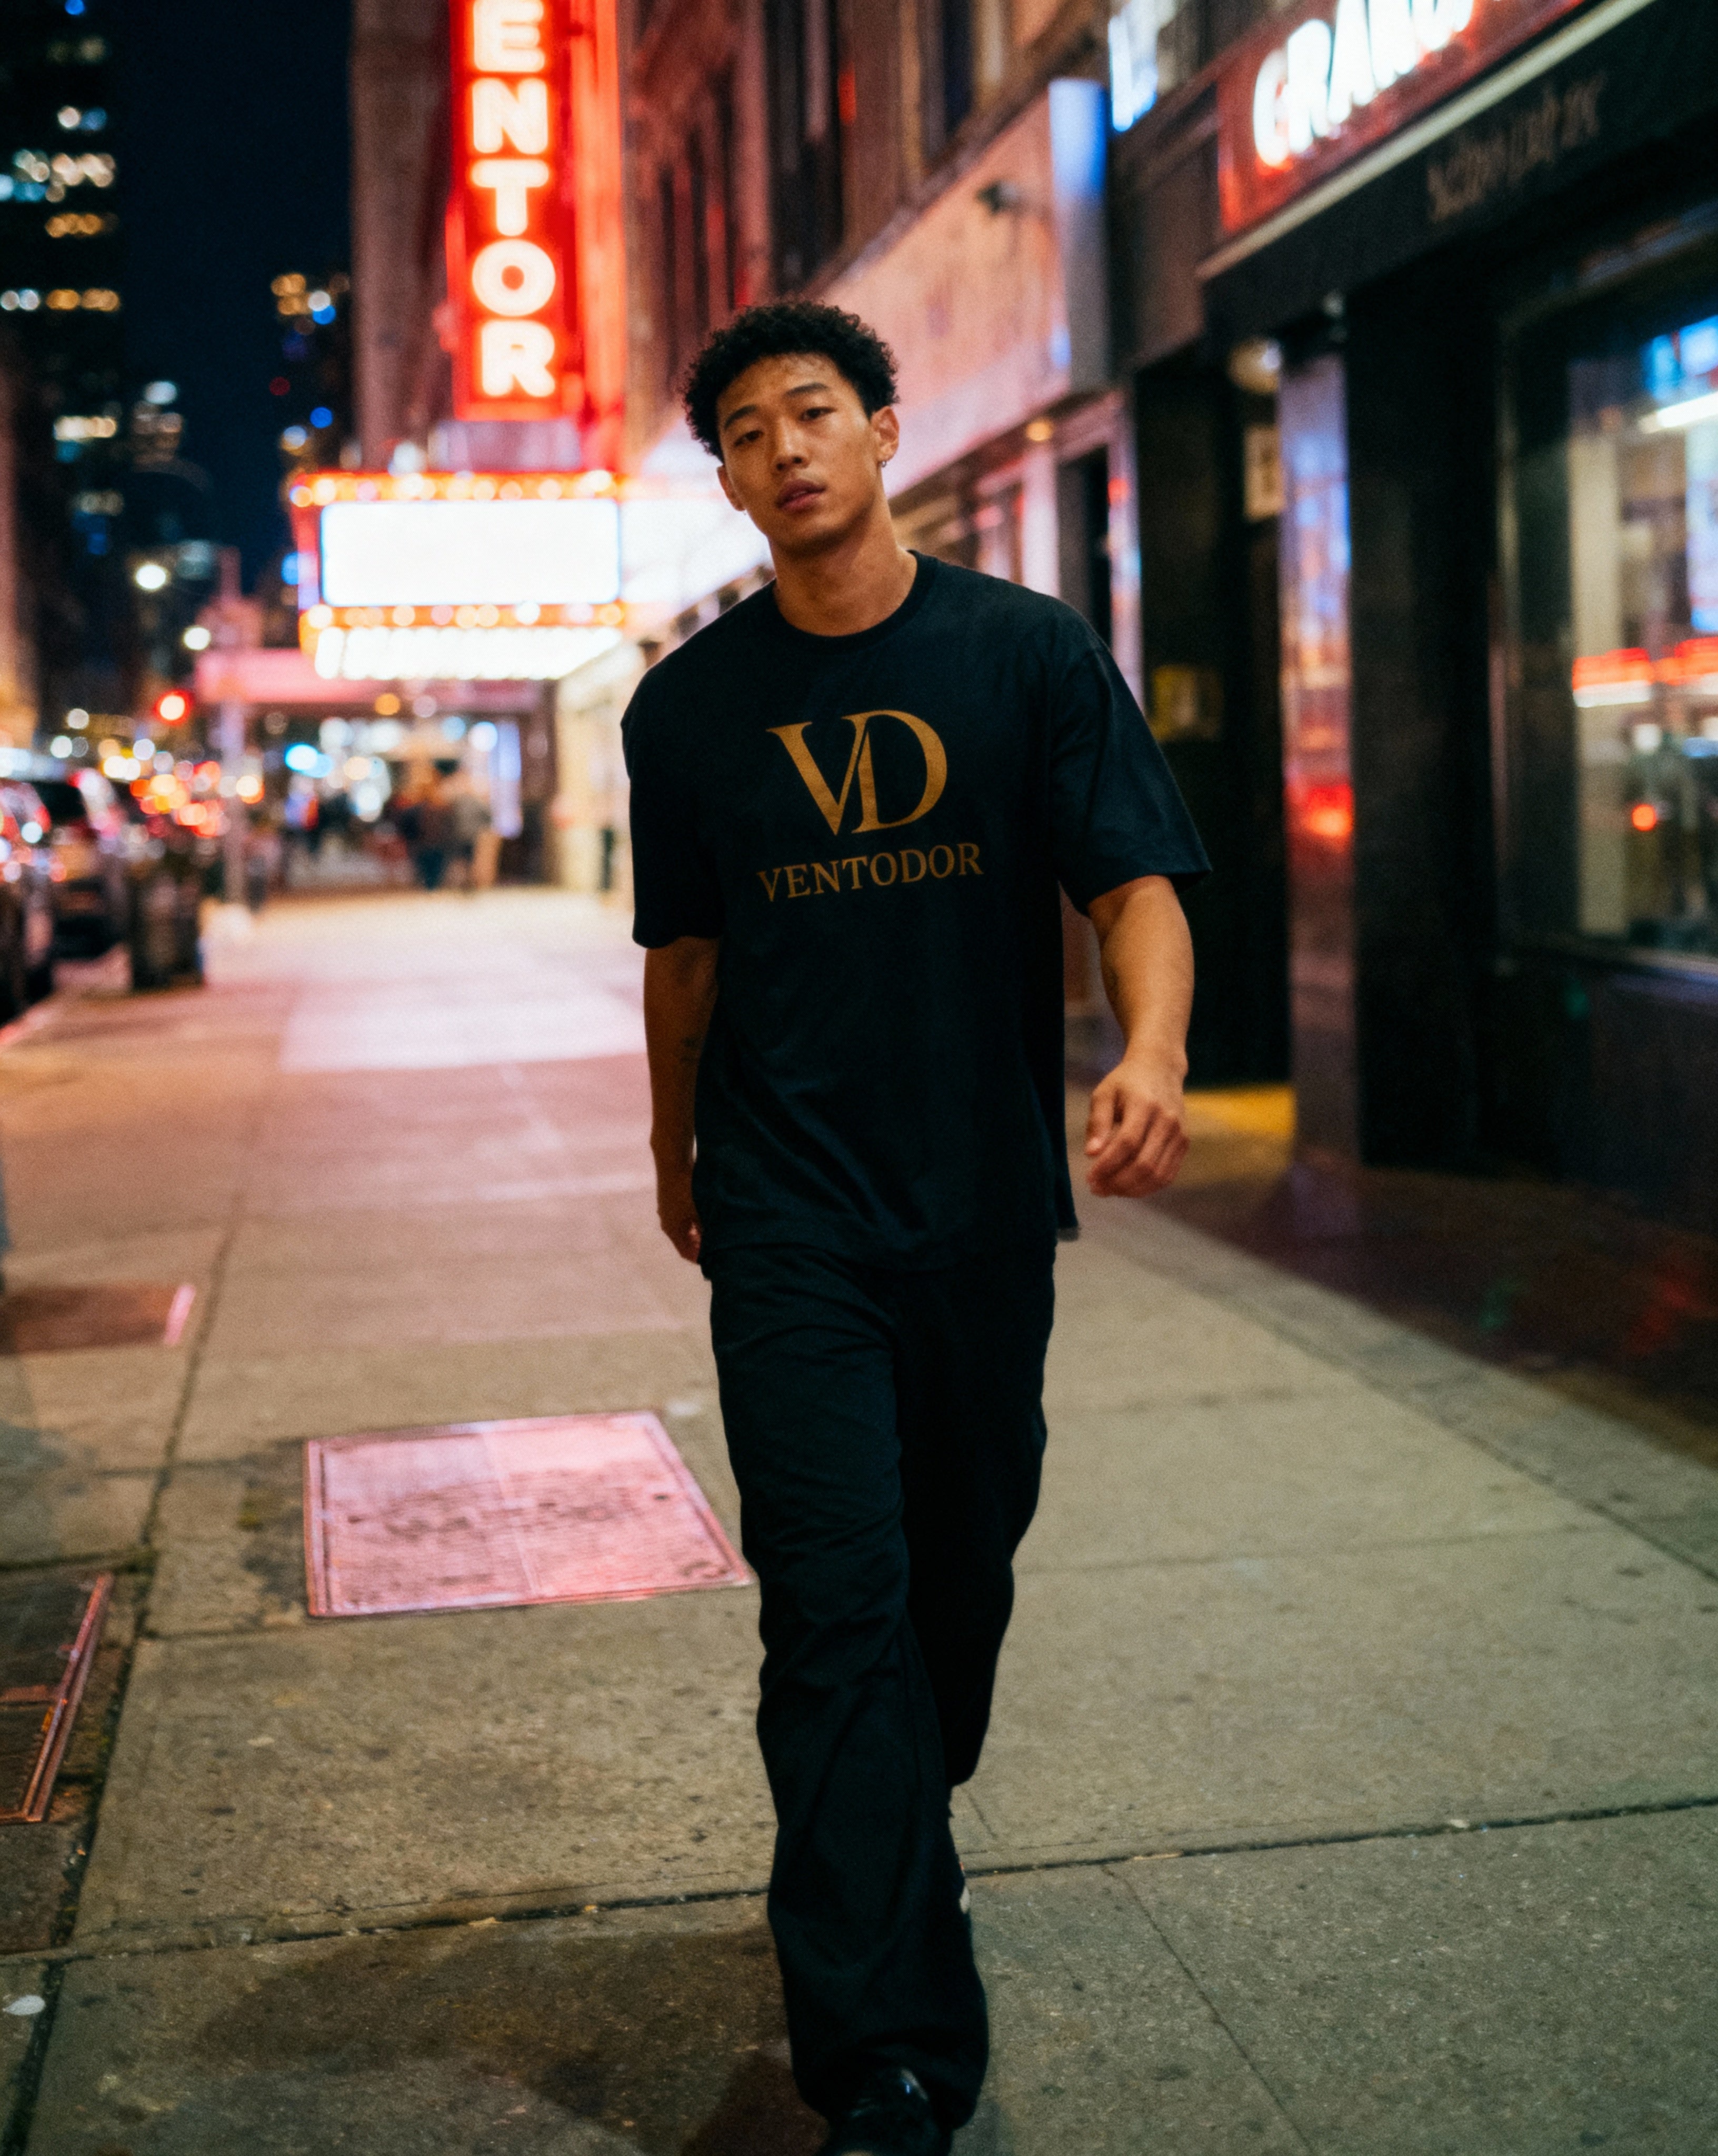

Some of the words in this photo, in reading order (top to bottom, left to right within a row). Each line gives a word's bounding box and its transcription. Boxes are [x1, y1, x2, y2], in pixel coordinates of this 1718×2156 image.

[473, 0, 556, 397] ENTOR
[766, 709, 948, 836] VD
[756, 842, 984, 902] VENTODOR
